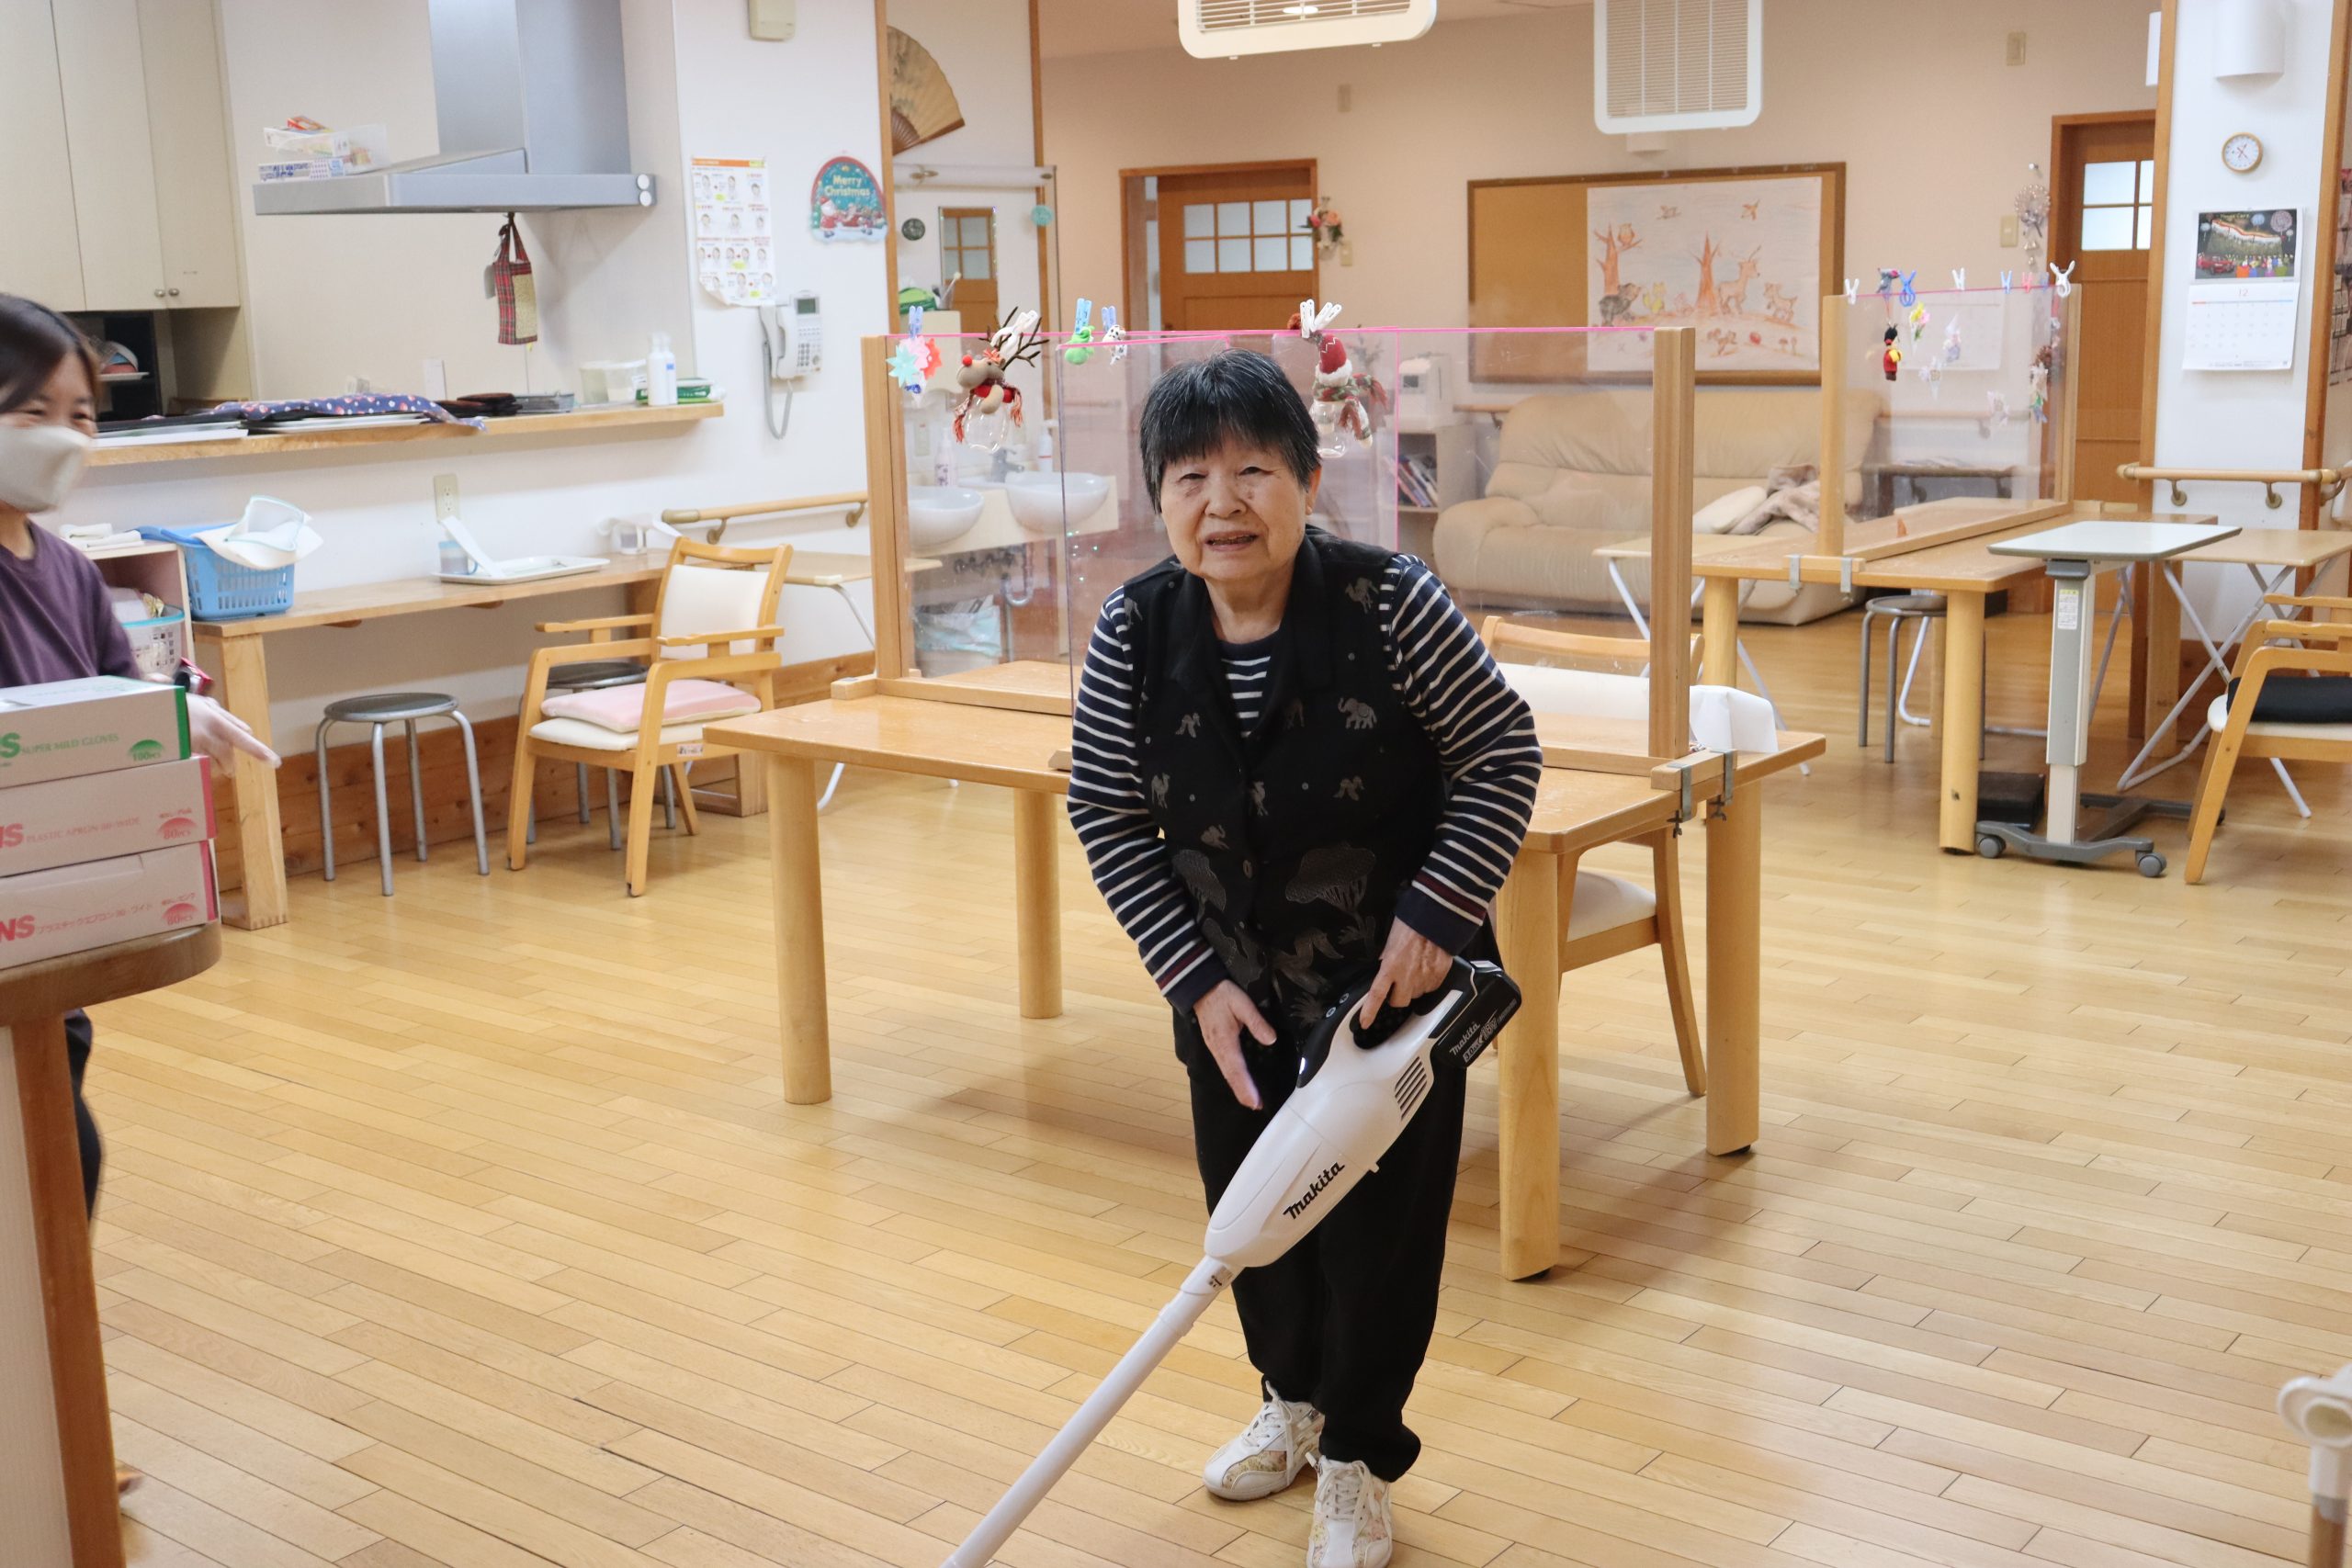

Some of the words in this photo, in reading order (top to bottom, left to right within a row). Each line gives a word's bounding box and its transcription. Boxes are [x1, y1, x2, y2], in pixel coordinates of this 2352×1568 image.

[833, 175, 862, 188] Merry
[824, 185, 871, 197] Christmas
[2238, 288, 2249, 299] 12
[81, 733, 119, 747] GLOVES
[26, 829, 64, 843] PLASTIC
